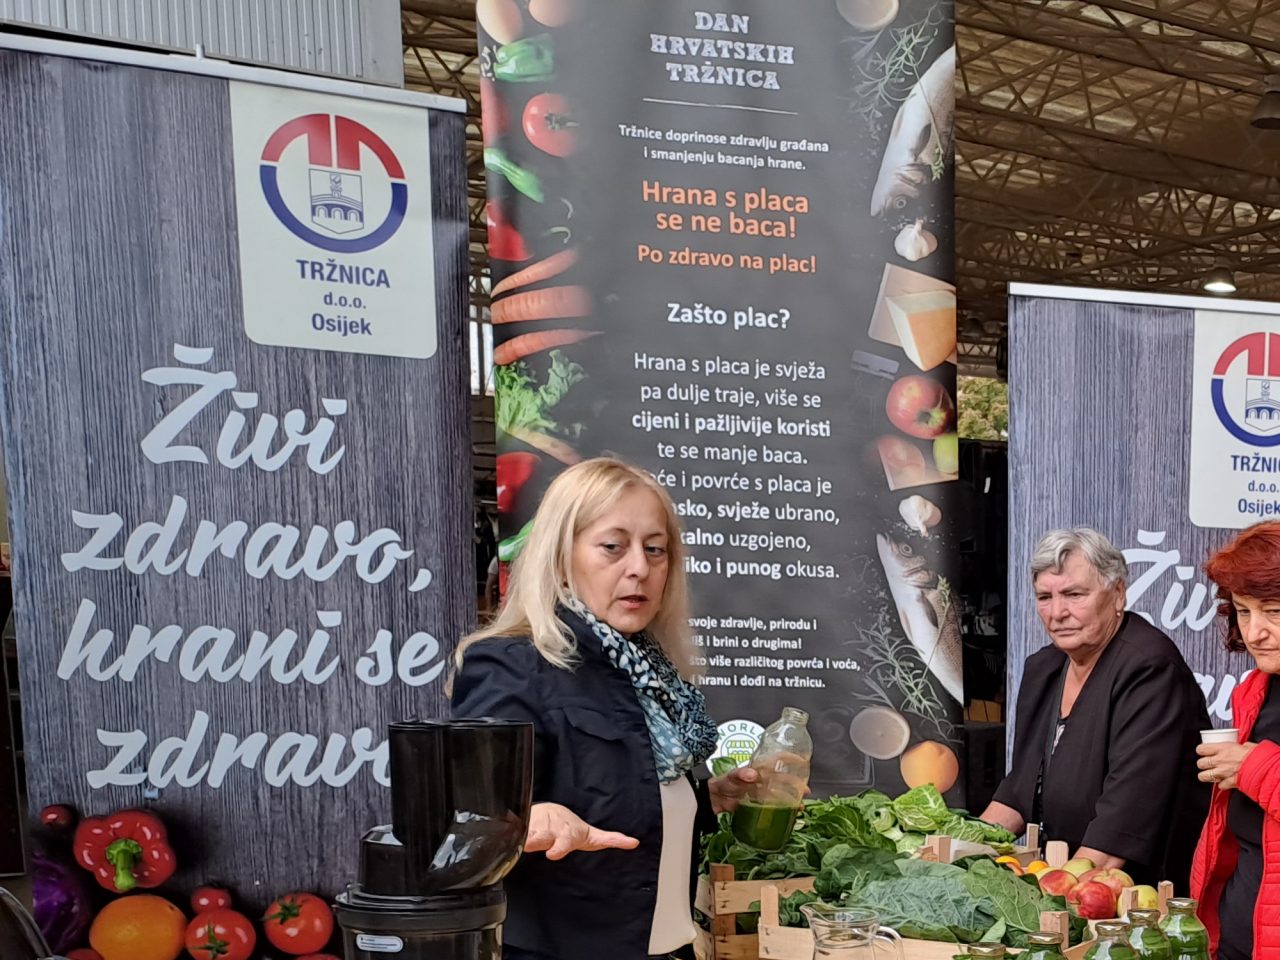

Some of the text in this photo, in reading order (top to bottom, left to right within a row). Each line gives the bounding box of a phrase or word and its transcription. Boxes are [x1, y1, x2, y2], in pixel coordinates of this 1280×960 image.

[695, 12, 749, 33] DAN
[651, 34, 794, 64] HRVATSKIH
[666, 61, 780, 90] TRŽNICA
[619, 125, 828, 152] Tržnice doprinose zdravlju građana
[651, 149, 806, 169] smanjenju bacanja hrane.
[642, 180, 808, 213] Hrana s placa
[656, 212, 796, 238] se ne baca!
[638, 245, 816, 274] Po zdravo na plac!
[296, 259, 390, 289] TRŽNICA
[323, 292, 366, 309] d.o.o.
[312, 314, 372, 337] Osijek
[667, 303, 790, 329] Zašto plac?
[634, 353, 825, 379] Hrana s placa je svježa
[641, 383, 821, 408] pa dulje traje, više se
[141, 343, 347, 474] Živi
[632, 411, 831, 436] cijeni i pažljivije koristi
[658, 442, 808, 465] te se manje baca.
[692, 472, 749, 491] povrće
[755, 478, 762, 491] s
[768, 476, 811, 494] placa
[816, 478, 832, 497] je
[1248, 480, 1279, 493] d.o.o.
[717, 501, 769, 521] svježe
[775, 506, 840, 525] ubrano,
[61, 495, 432, 591] zdravo,
[729, 531, 811, 551] uzgojeno,
[716, 557, 721, 574] i
[727, 560, 781, 580] punog
[786, 562, 840, 578] okusa.
[1121, 529, 1227, 632] Živ
[688, 616, 811, 632] svoje zdravlje, prirodu
[57, 599, 445, 686] hrani se
[713, 635, 739, 648] brini
[742, 638, 749, 648] o
[752, 637, 802, 651] drugima!
[709, 655, 731, 666] više
[734, 656, 784, 670] različitog
[787, 657, 824, 670] povrća
[833, 658, 861, 671] voća,
[740, 675, 766, 687] dođi
[769, 679, 782, 687] na
[785, 676, 826, 688] tržnicu.
